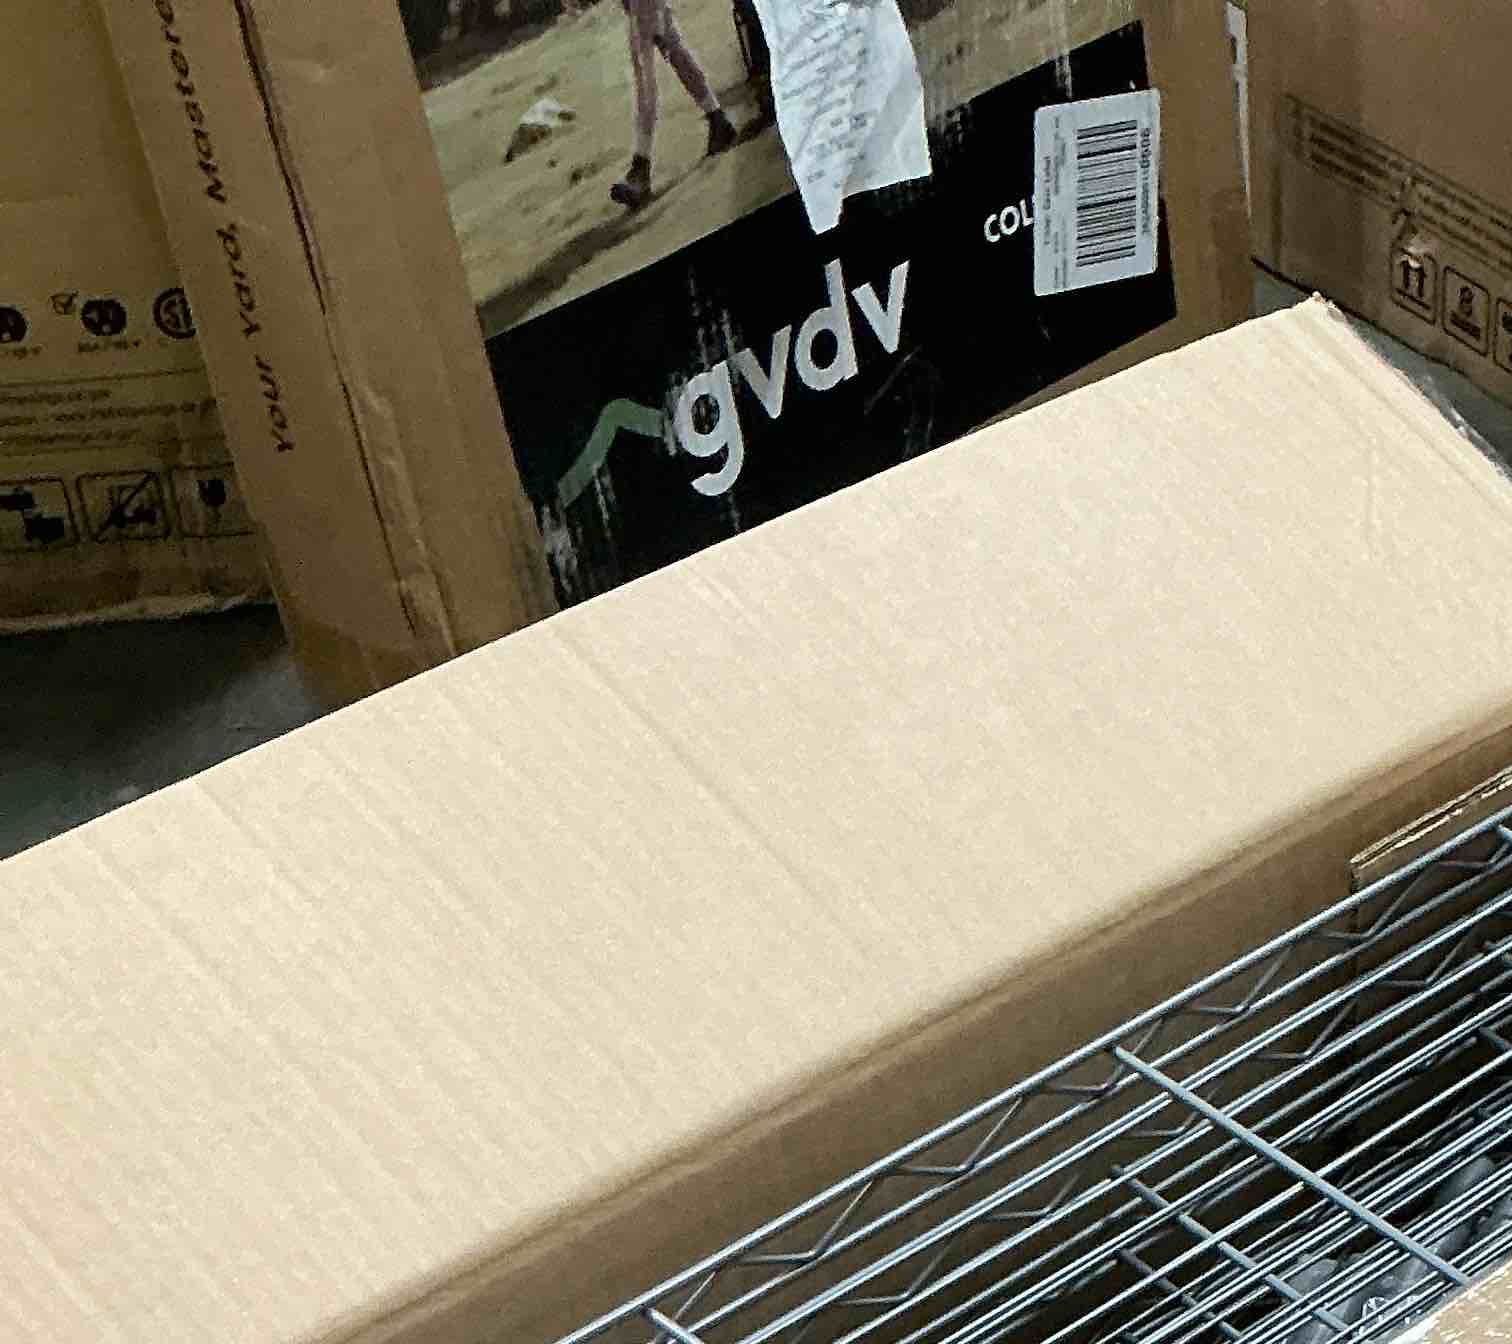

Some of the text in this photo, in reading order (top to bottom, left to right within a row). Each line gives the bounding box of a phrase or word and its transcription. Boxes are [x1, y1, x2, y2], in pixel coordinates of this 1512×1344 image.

[984, 194, 1034, 243] COL
[254, 354, 293, 452] Your
[674, 257, 911, 497] gvdv
